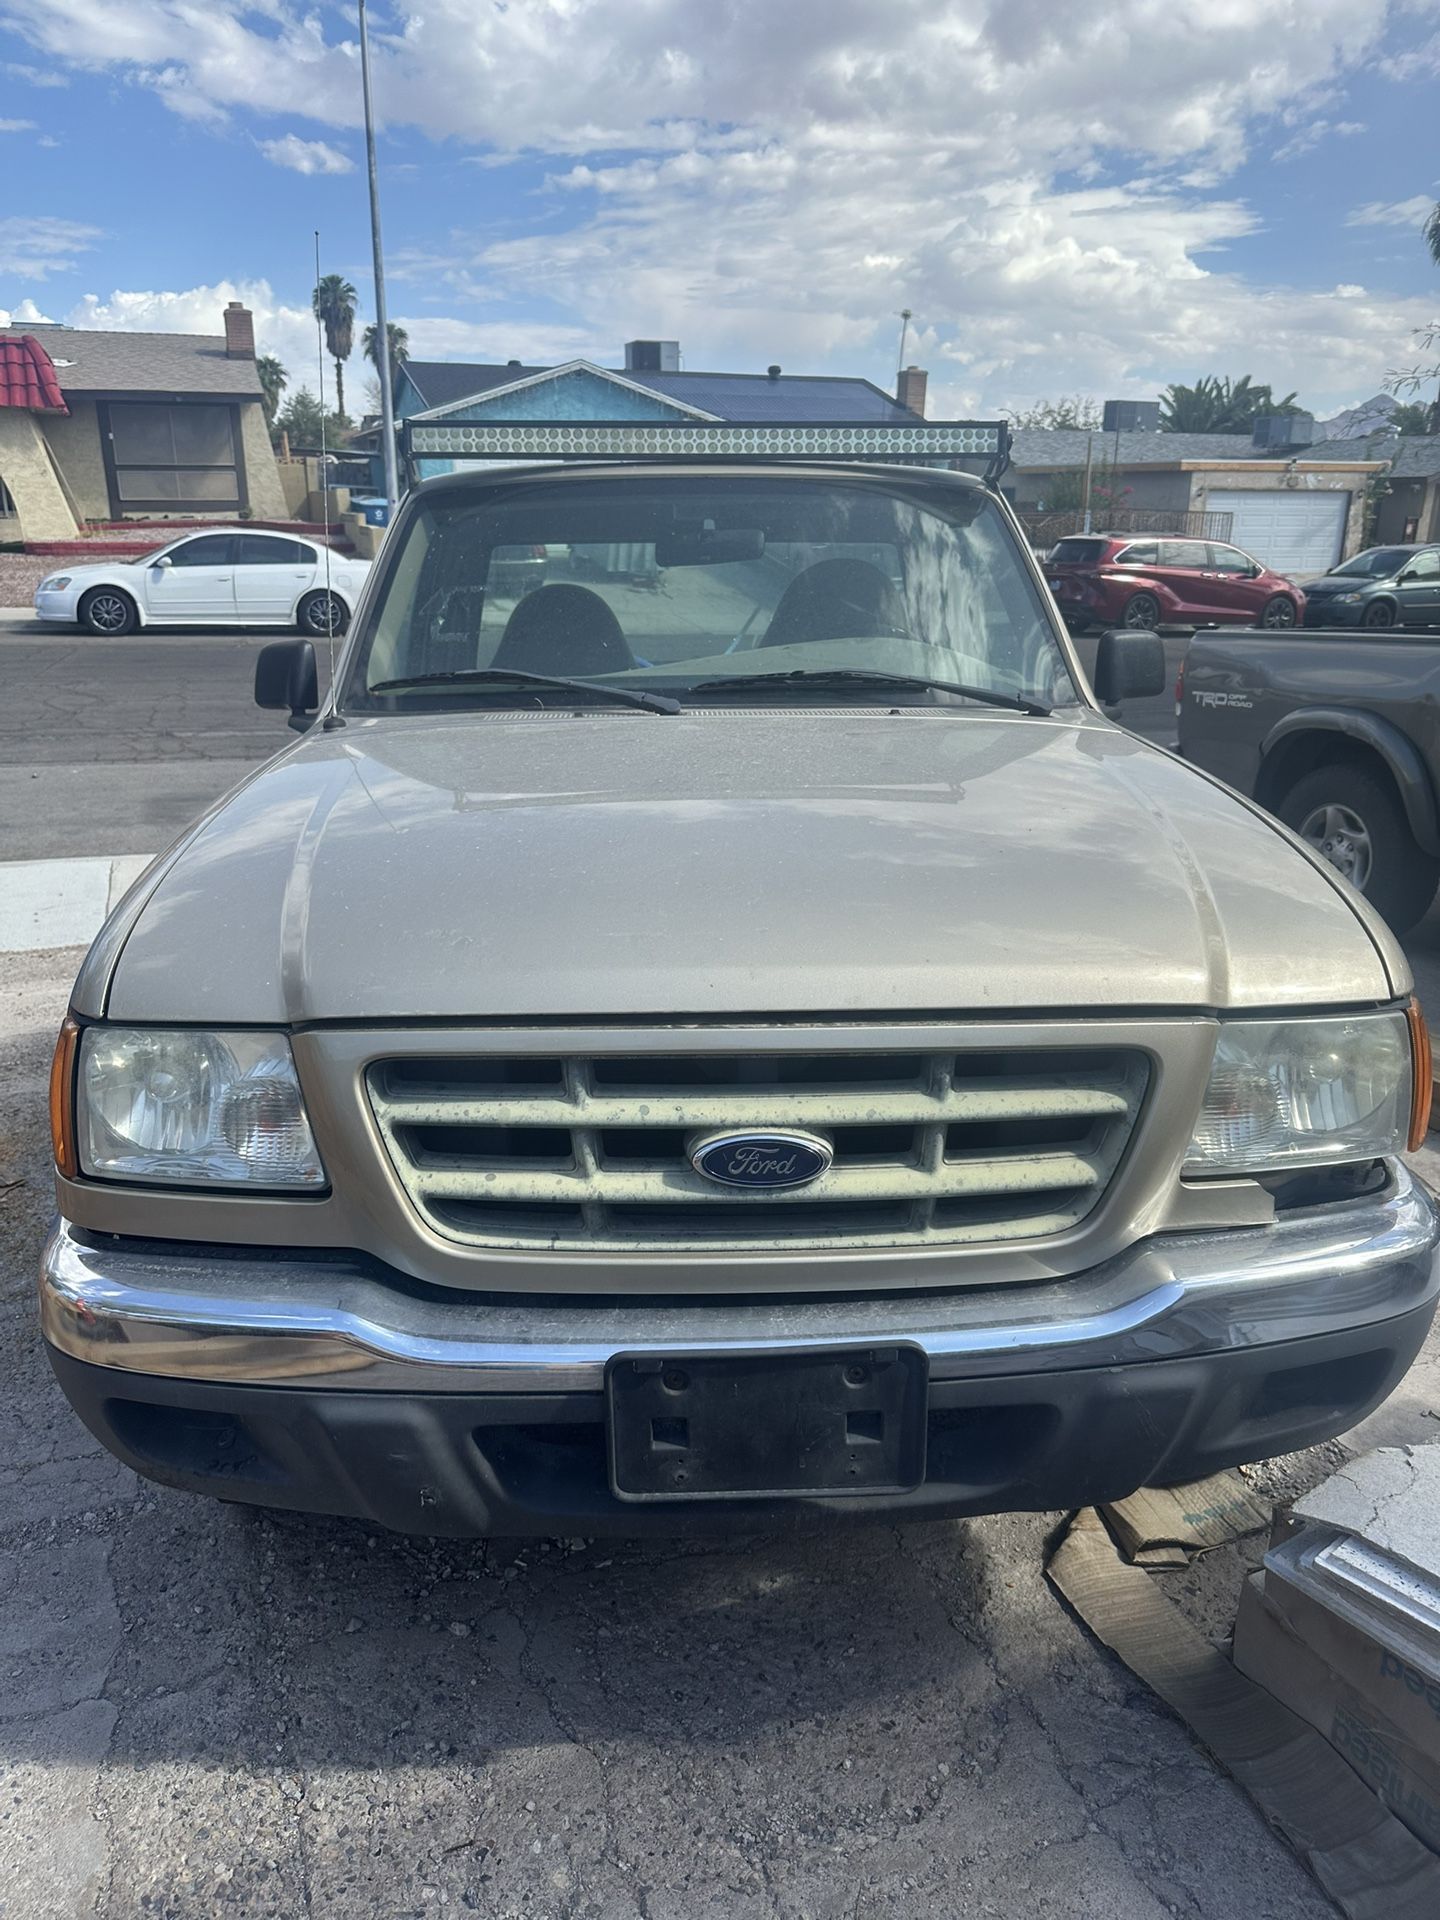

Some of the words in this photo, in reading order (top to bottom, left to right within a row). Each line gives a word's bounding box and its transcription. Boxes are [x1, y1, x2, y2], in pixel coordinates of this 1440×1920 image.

[1192, 691, 1227, 708] TRD
[1227, 700, 1253, 708] ROAD
[728, 1146, 797, 1175] Ford
